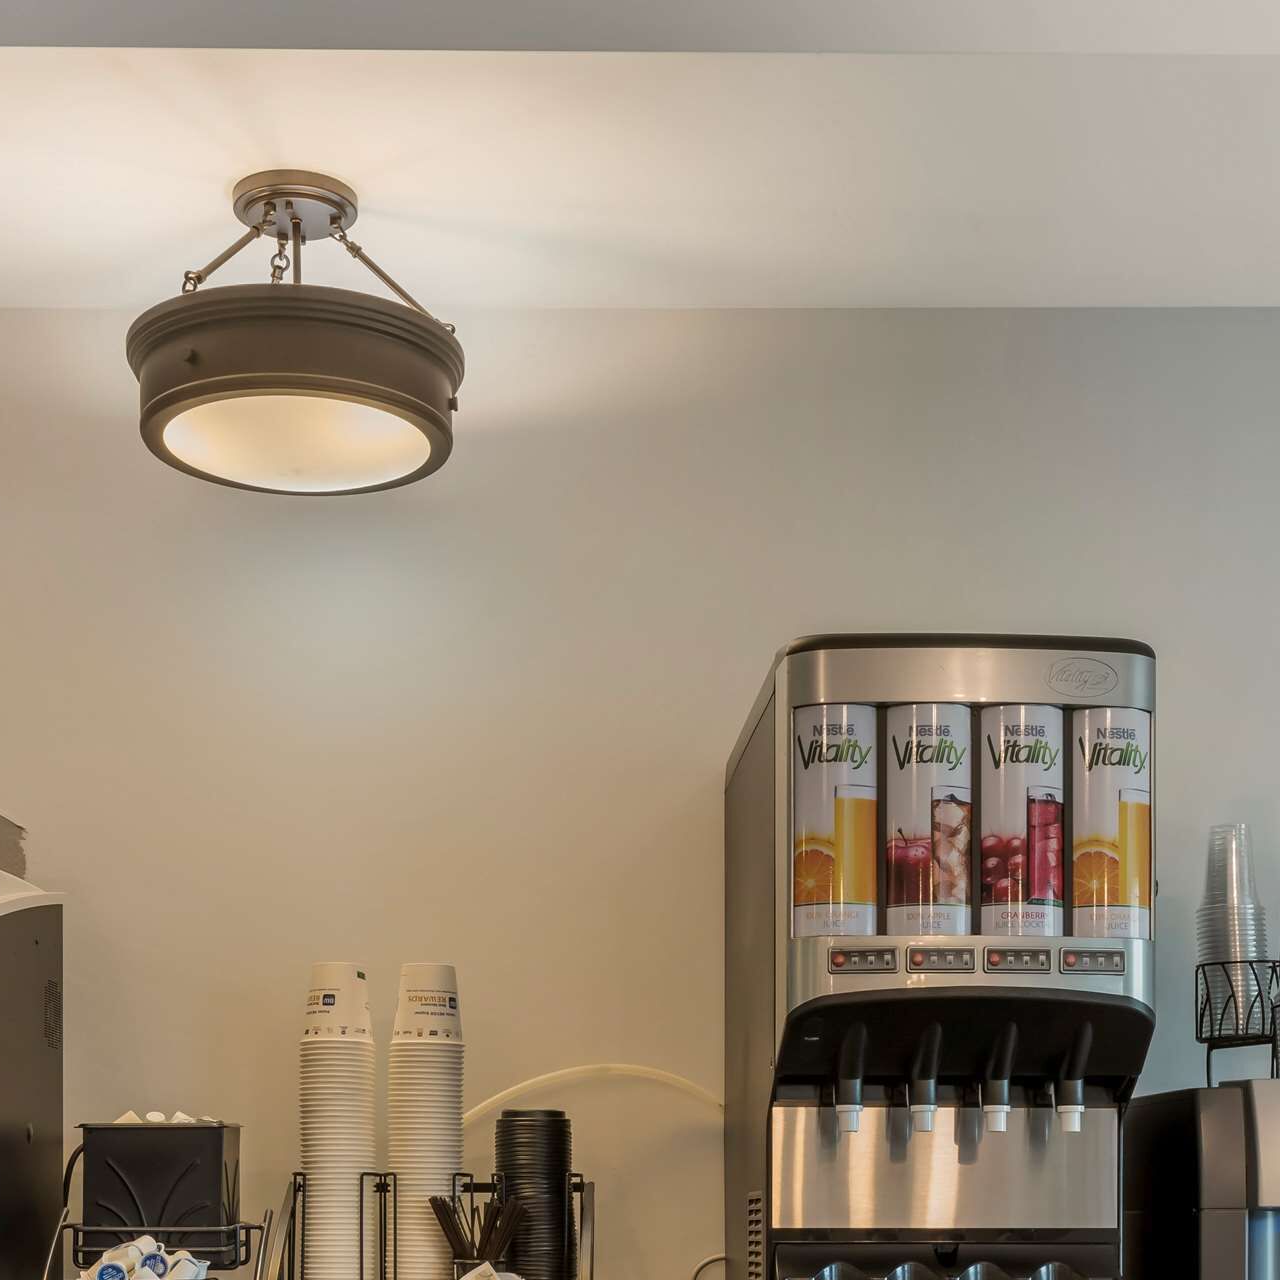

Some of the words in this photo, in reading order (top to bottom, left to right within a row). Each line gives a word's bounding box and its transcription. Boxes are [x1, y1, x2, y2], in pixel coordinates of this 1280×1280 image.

[797, 735, 872, 770] Vitality
[892, 735, 967, 771] Vitality
[987, 734, 1060, 771] Vitality
[1079, 736, 1149, 774] Vitality
